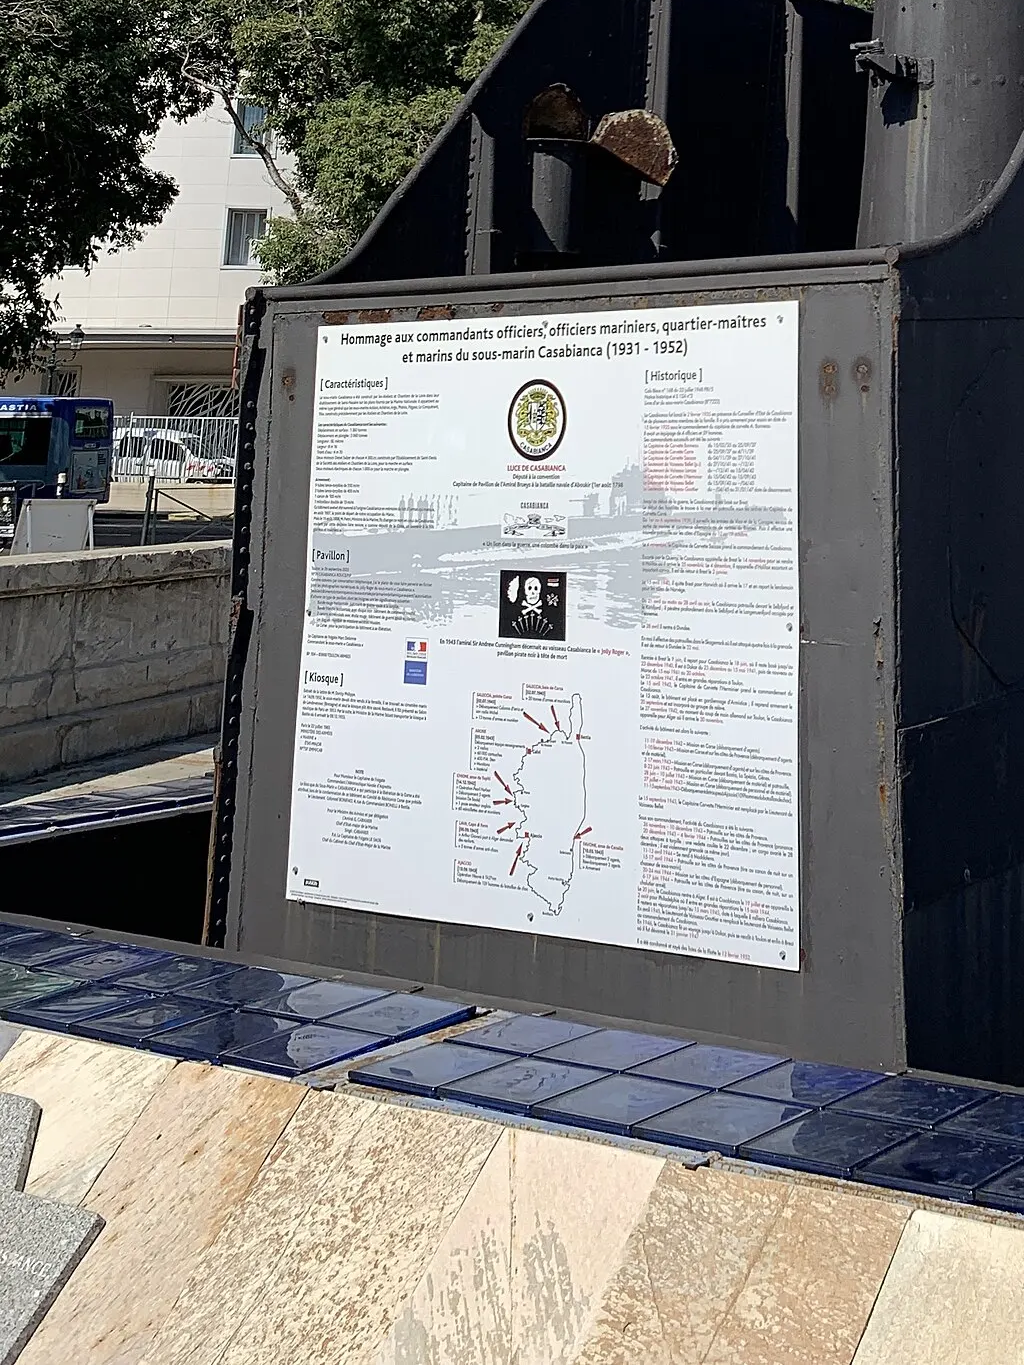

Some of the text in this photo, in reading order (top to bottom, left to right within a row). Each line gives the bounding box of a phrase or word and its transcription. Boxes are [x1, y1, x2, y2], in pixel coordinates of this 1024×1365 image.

[341, 316, 766, 347] Hommage aux commandants officiers, officiers mariniers, quartier-maîtres
[402, 351, 413, 363] et
[416, 350, 452, 362] marins
[456, 348, 469, 362] du
[472, 347, 534, 361] sous-marin
[538, 344, 602, 358] Casabianca
[606, 341, 640, 359] (1931
[653, 338, 688, 356] 1952)
[650, 370, 696, 383] Historique
[325, 378, 383, 390] Caractéristiques
[520, 442, 552, 454] CASABIANCA
[316, 550, 345, 560] Pavillon
[309, 672, 338, 686] Kiosque
